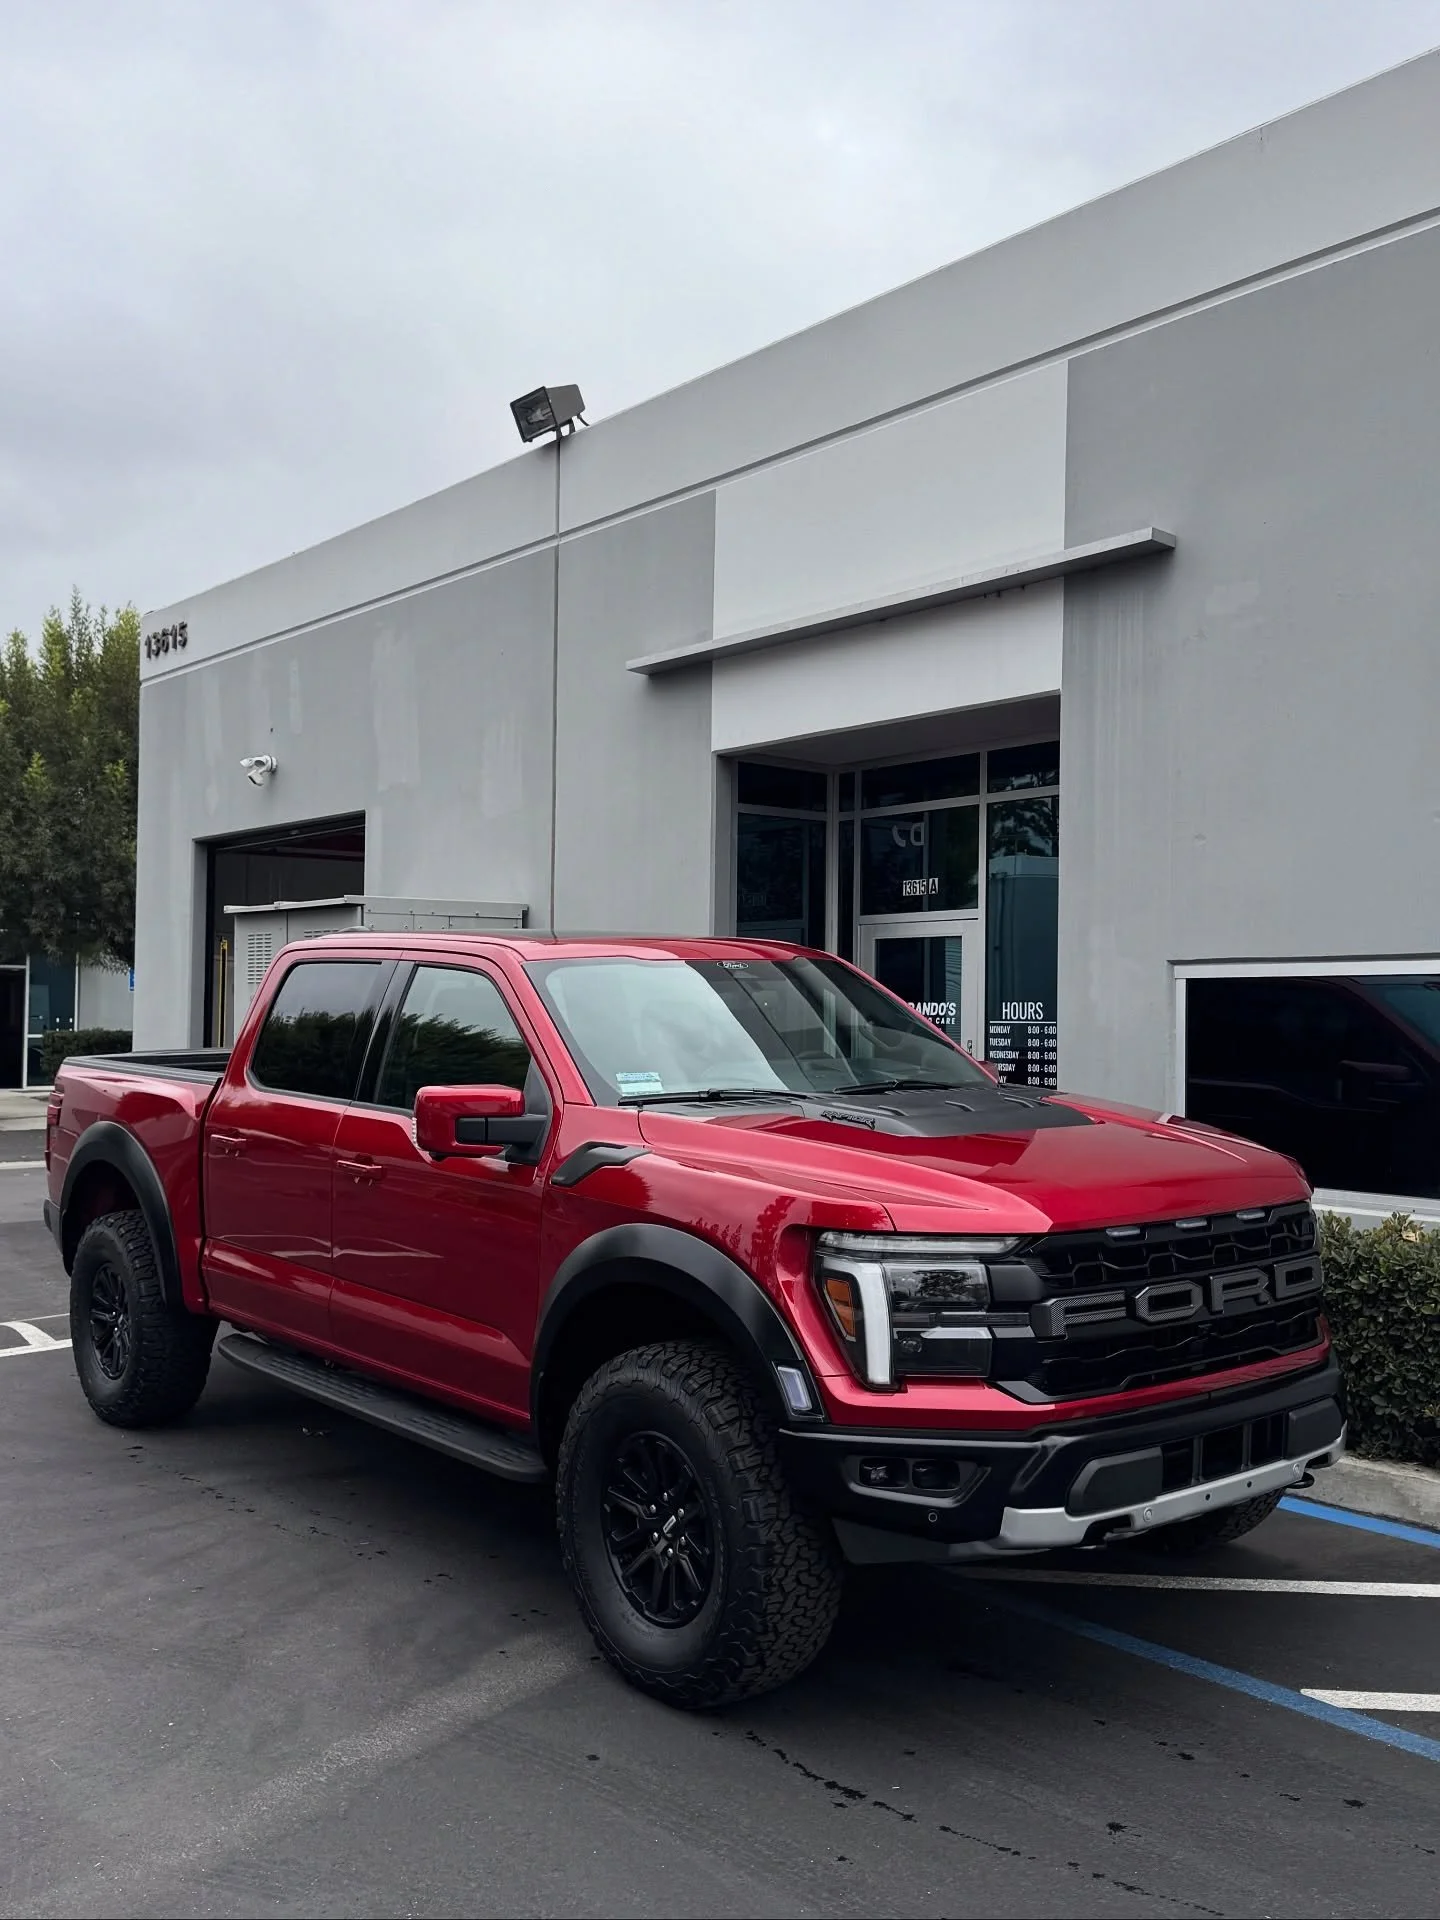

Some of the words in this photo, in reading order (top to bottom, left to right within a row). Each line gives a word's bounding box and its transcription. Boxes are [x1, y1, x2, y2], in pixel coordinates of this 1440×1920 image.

[144, 621, 188, 660] 13615
[903, 879, 926, 896] 13615
[929, 878, 938, 894] A
[1002, 1001, 1044, 1020] HOURS
[935, 1017, 956, 1025] CARE
[989, 1025, 1011, 1034] MONDAY
[989, 1037, 1011, 1047] TUESDAY
[989, 1050, 1020, 1059] WEDNESDAY
[997, 1063, 1016, 1072] RSDAY
[1032, 1254, 1324, 1342] FORD
